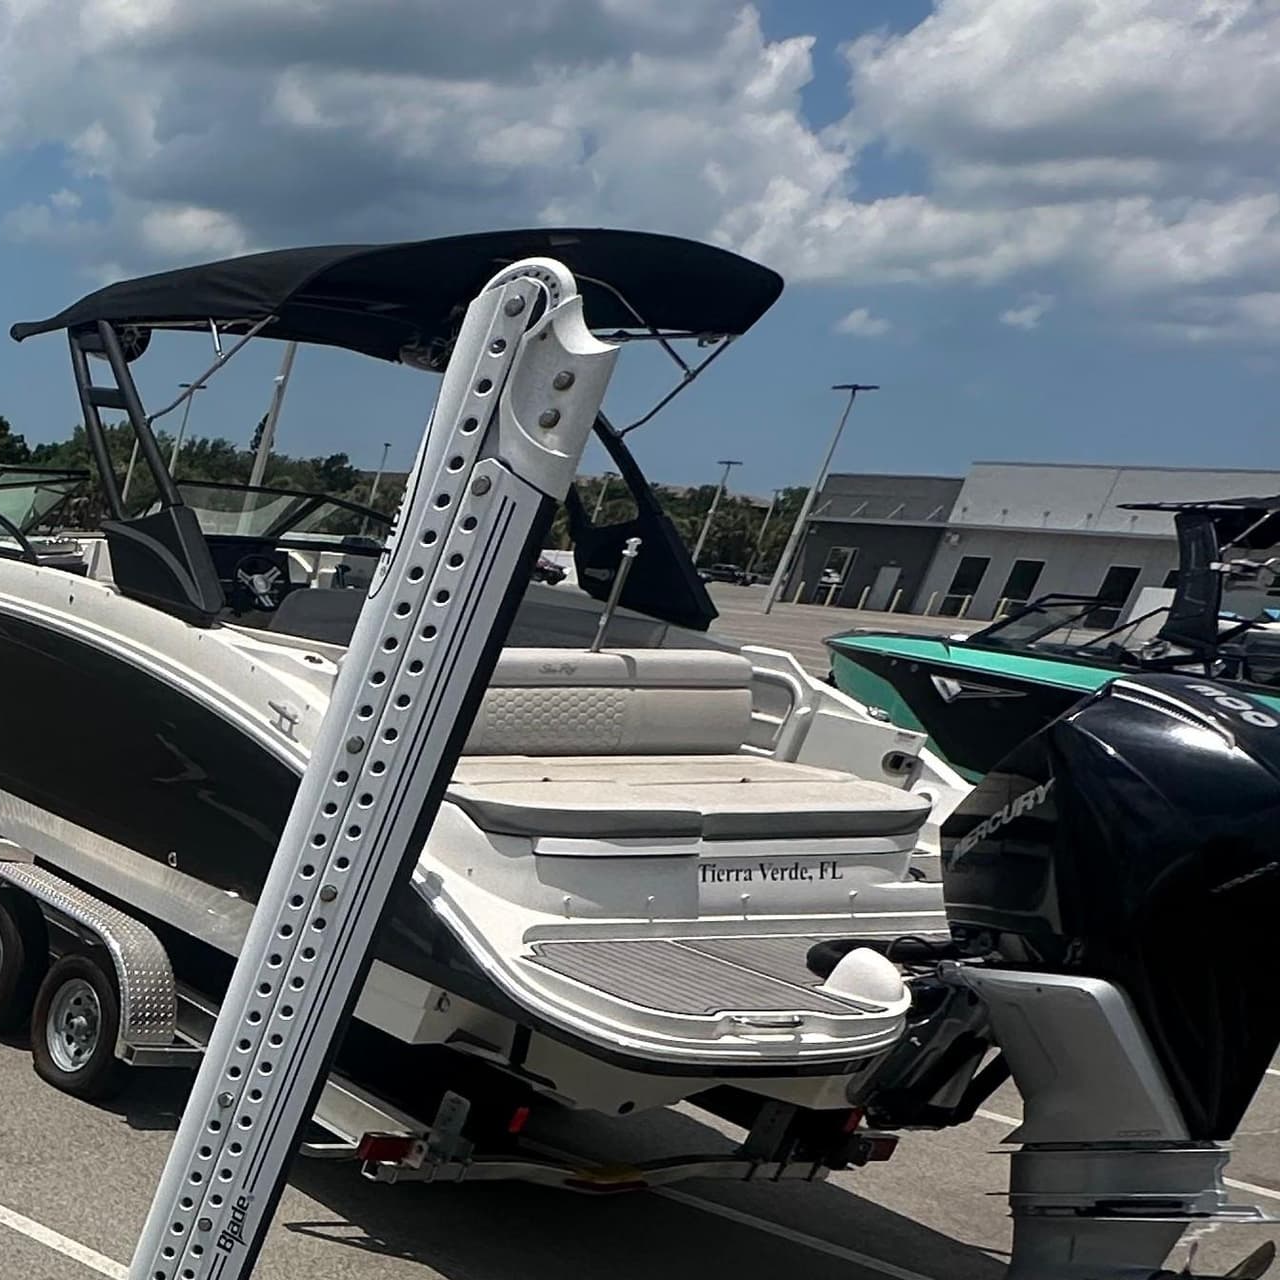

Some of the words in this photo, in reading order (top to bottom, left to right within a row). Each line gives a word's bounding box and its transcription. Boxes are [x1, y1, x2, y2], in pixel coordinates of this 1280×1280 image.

[1183, 684, 1279, 728] 300
[698, 863, 753, 883] Tierra
[758, 861, 814, 884] Verde,
[818, 861, 844, 880] FL
[216, 1195, 249, 1254] Blade
